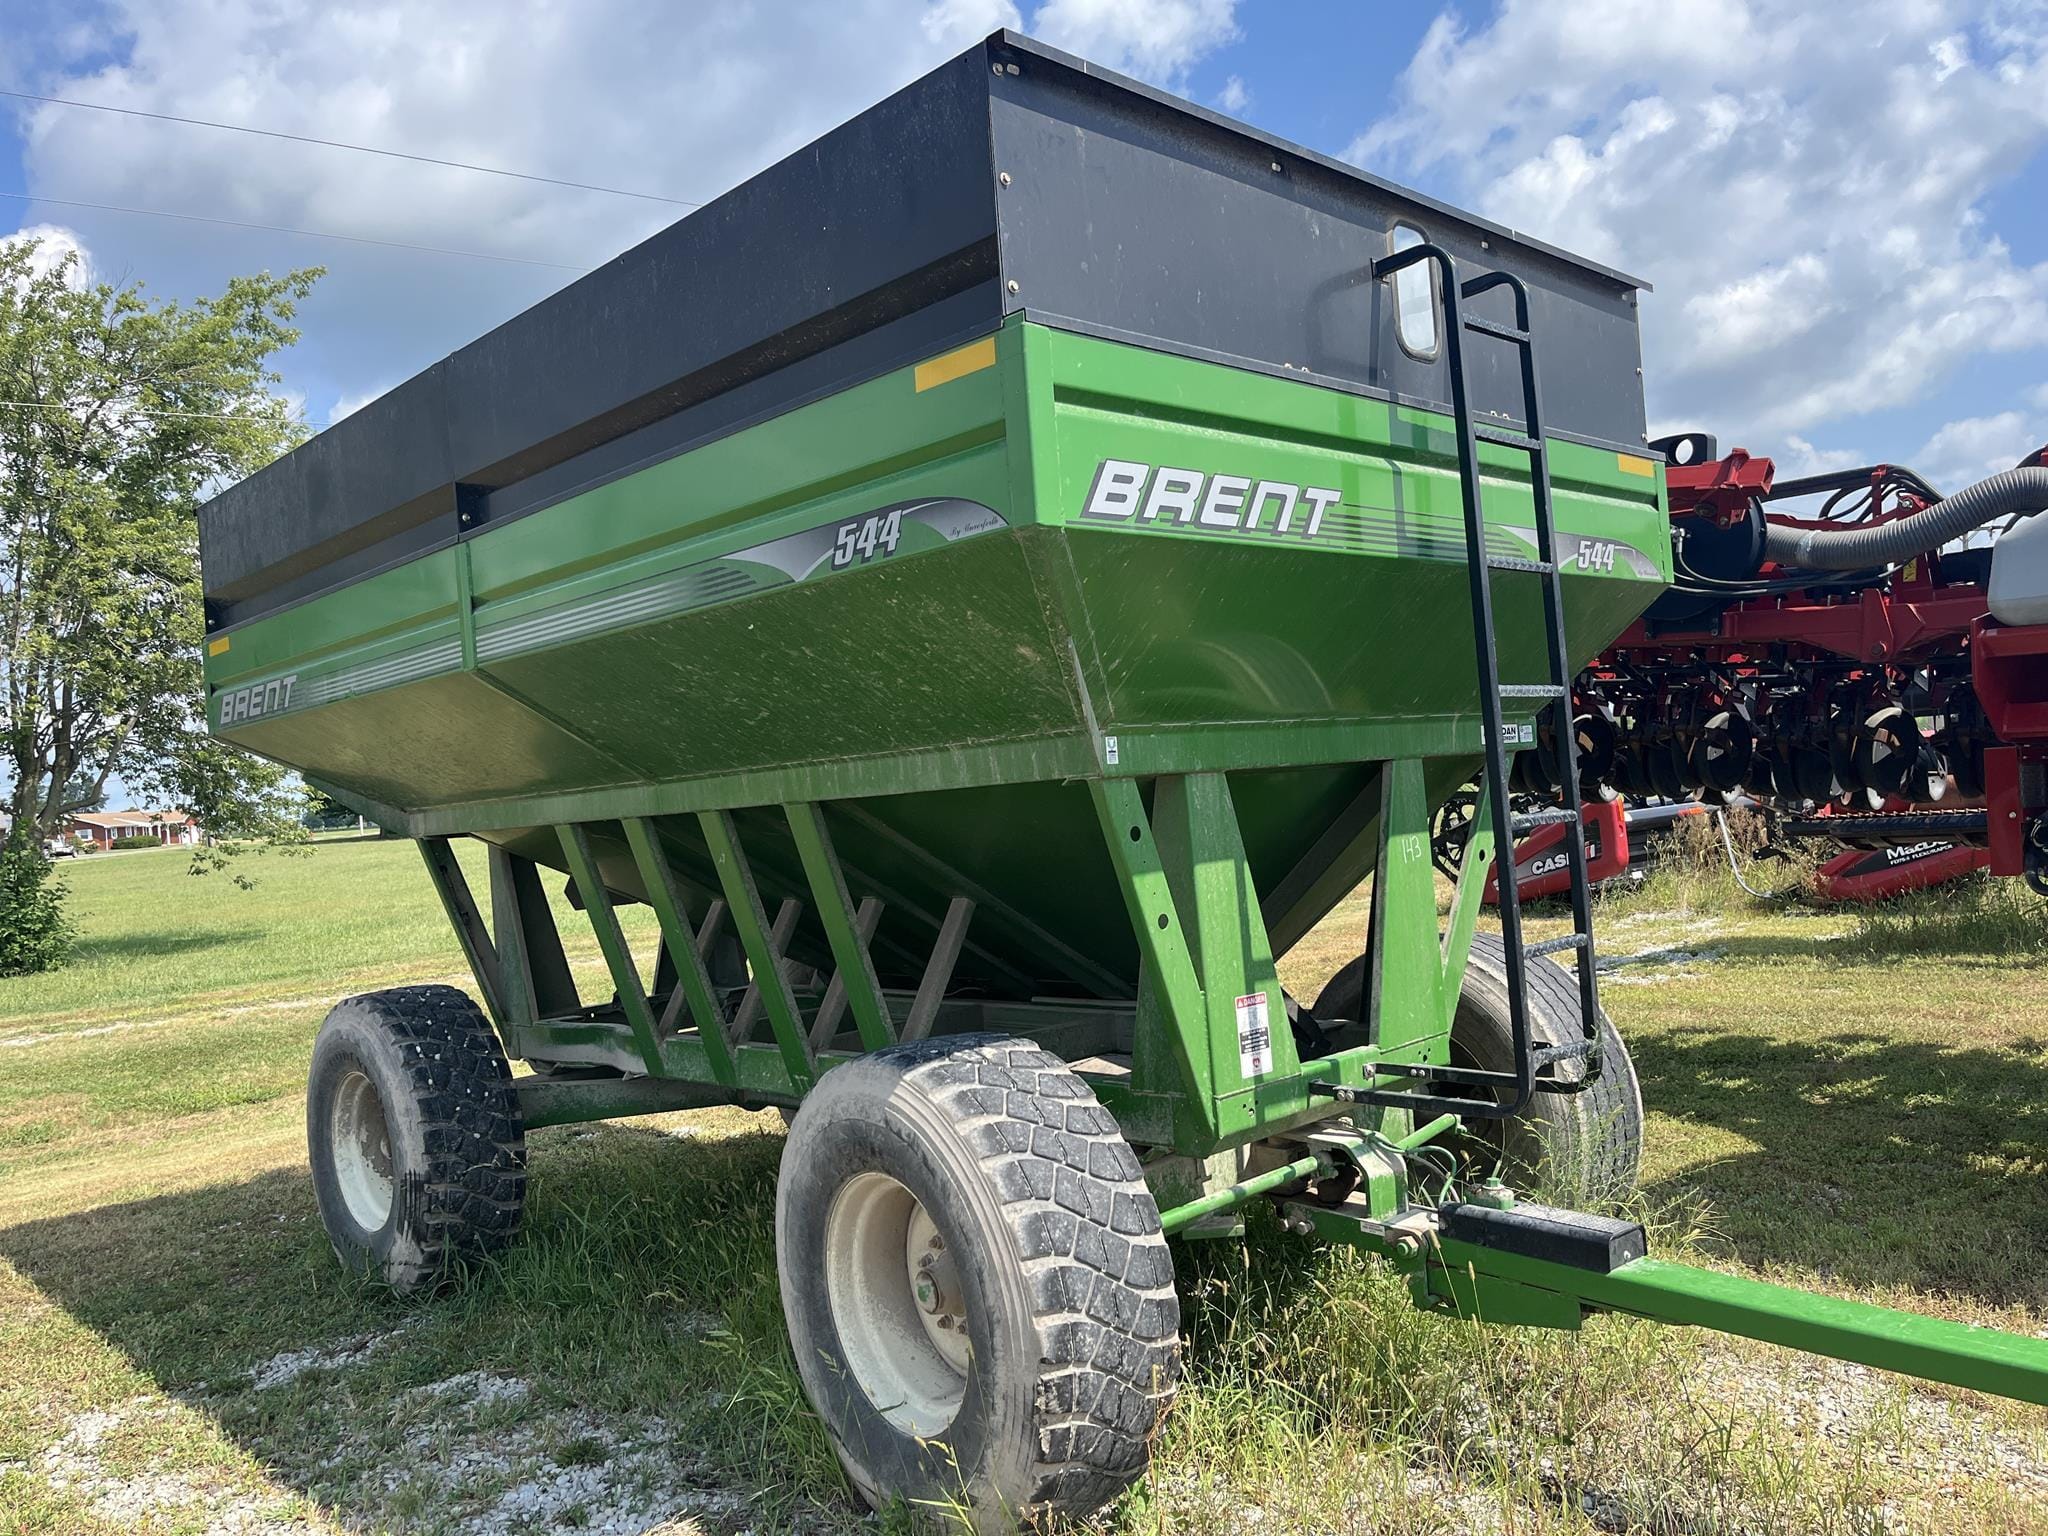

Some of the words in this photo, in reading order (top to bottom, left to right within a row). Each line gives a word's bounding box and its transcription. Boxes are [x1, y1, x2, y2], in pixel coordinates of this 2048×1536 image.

[1081, 458, 1342, 539] BRENT
[832, 509, 902, 570] 544
[1577, 540, 1615, 572] 544
[220, 675, 298, 726] BRENT
[1401, 835, 1422, 864] 143
[1532, 852, 1570, 875] CAS
